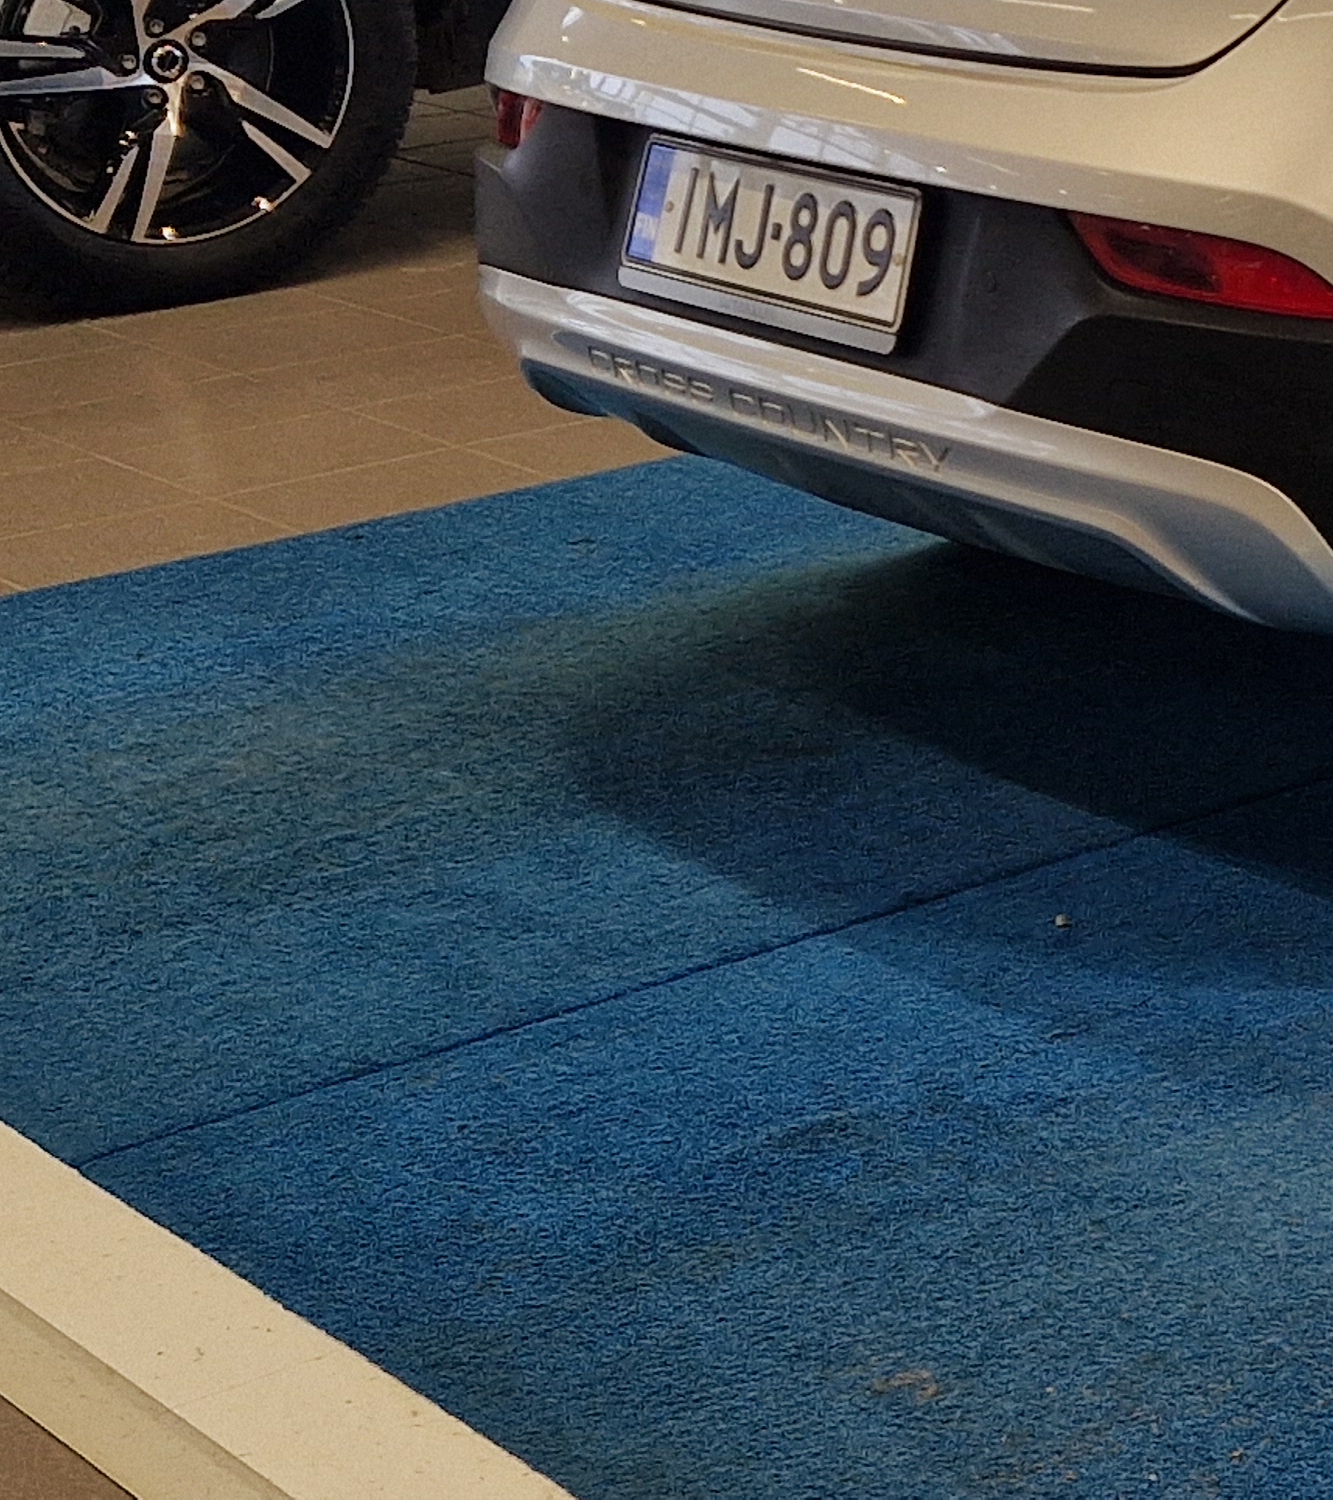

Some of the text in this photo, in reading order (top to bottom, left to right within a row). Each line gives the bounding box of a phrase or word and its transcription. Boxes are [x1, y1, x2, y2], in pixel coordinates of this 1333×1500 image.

[673, 167, 897, 297] IMJ-809
[587, 345, 951, 473] CROSS COUNTRY
